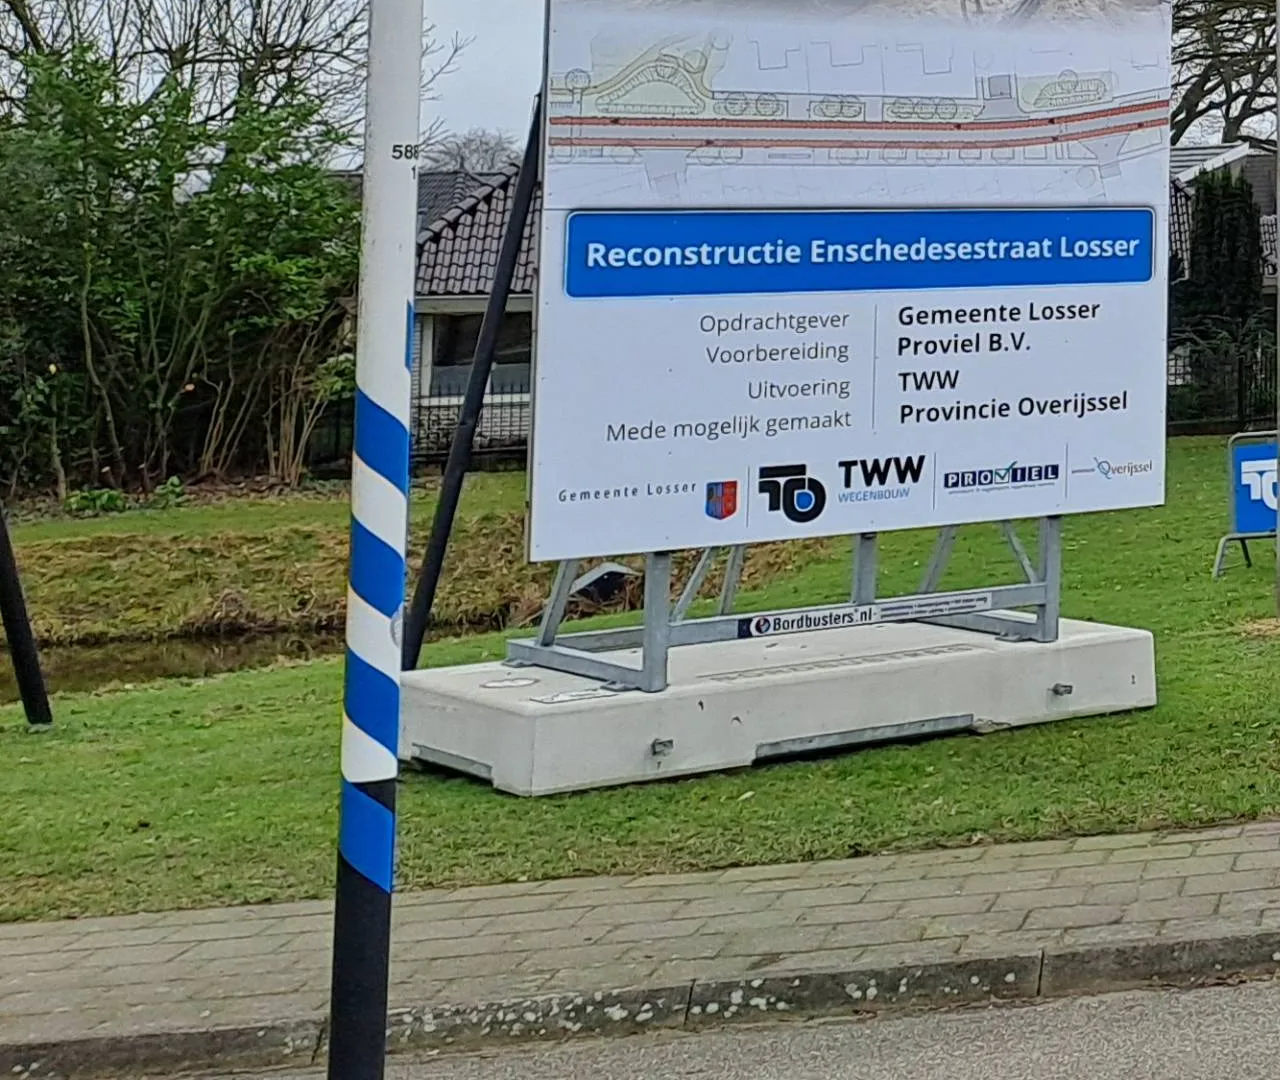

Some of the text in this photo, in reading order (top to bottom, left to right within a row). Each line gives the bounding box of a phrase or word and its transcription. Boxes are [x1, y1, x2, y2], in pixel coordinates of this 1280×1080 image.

[587, 235, 1140, 268] Reconstructie Enschedesestraat Losser
[700, 312, 850, 336] Opdrachtgever
[899, 302, 1101, 326] Gemeente Losser
[706, 341, 850, 364] Voorbereiding
[898, 331, 1032, 356] Proviel B.V.
[748, 378, 851, 399] Uitvoering
[898, 369, 960, 392] TWW
[899, 390, 1128, 424] Provincie Overijssel
[606, 411, 852, 442] Mede mogelijk gemaakt
[838, 454, 926, 489] TWW
[558, 481, 697, 503] Gemeente Losser
[838, 488, 910, 503] WEGENBOUW
